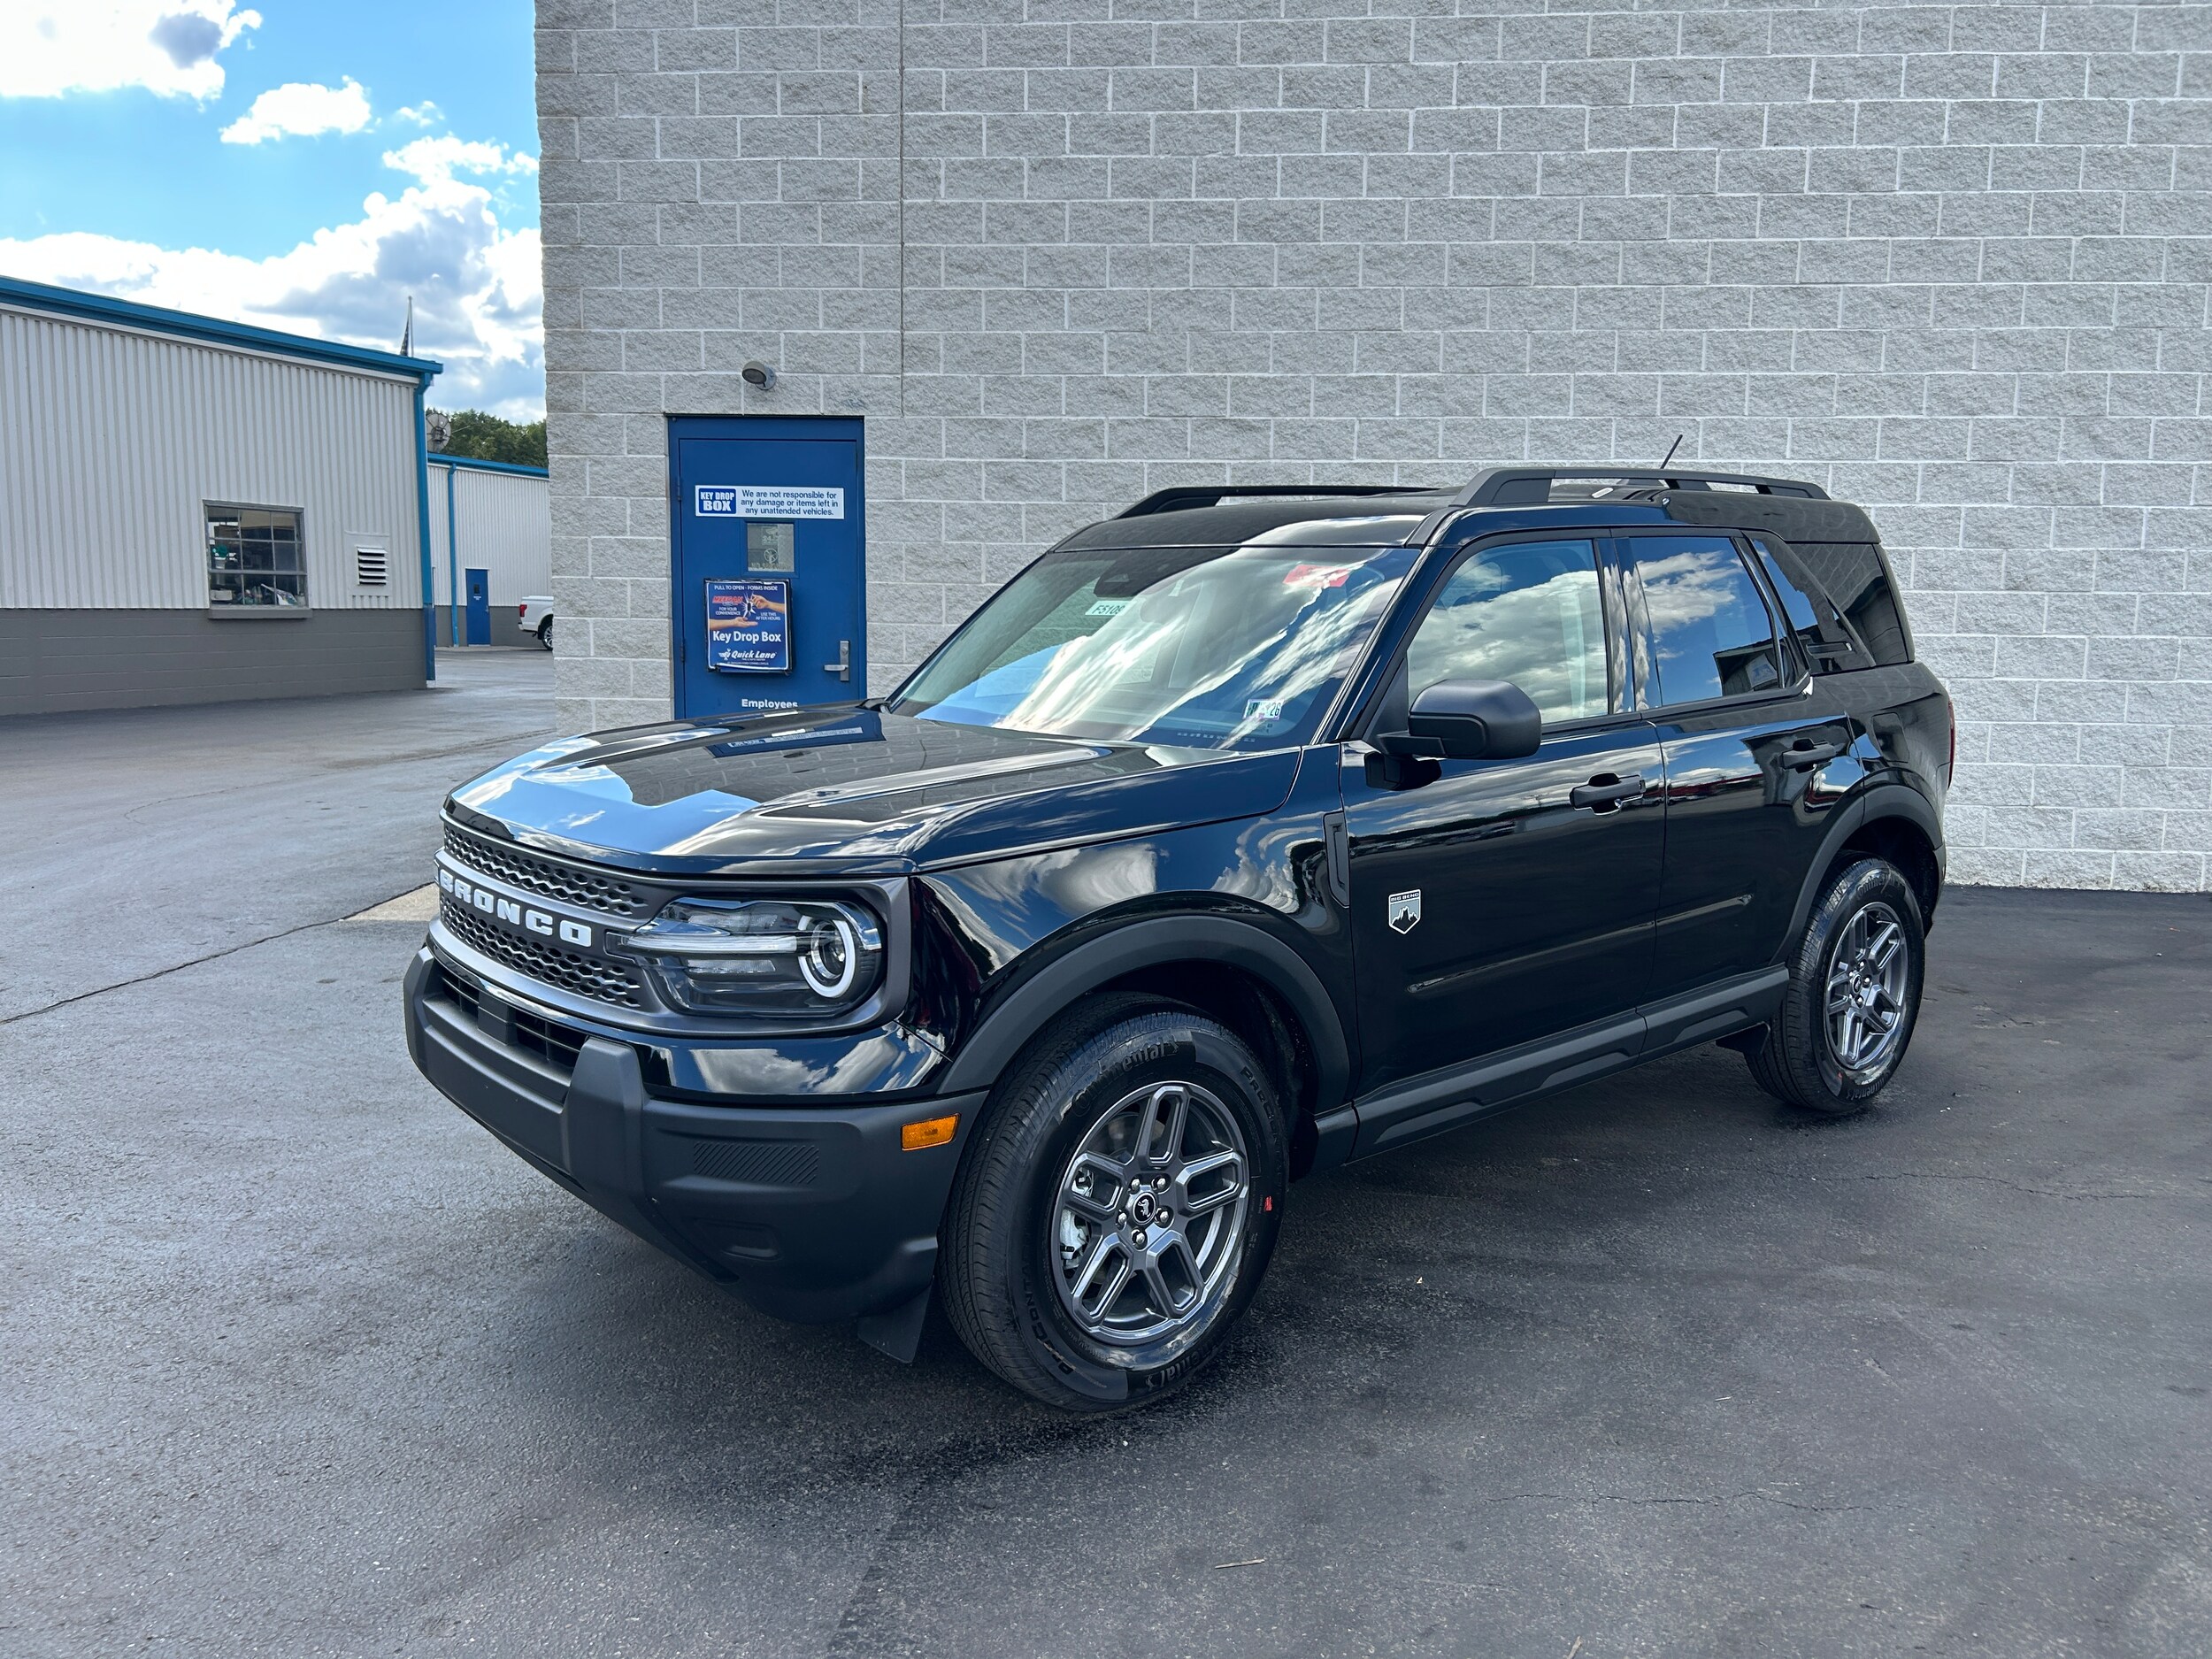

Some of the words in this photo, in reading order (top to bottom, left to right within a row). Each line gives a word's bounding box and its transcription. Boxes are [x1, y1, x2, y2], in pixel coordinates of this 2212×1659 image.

[701, 491, 713, 500] KEY
[715, 492, 735, 501] DROP
[783, 490, 824, 501] responsible
[703, 501, 732, 511] BOX
[757, 498, 784, 508] damage
[761, 506, 801, 515] unattended
[803, 507, 834, 516] vehicles.
[712, 630, 732, 644] Key
[733, 631, 760, 644] Drop
[761, 631, 782, 642] Box
[731, 649, 755, 659] Quick
[755, 650, 777, 659] Lane
[741, 698, 799, 710] Employees
[438, 868, 593, 948] BRONCO
